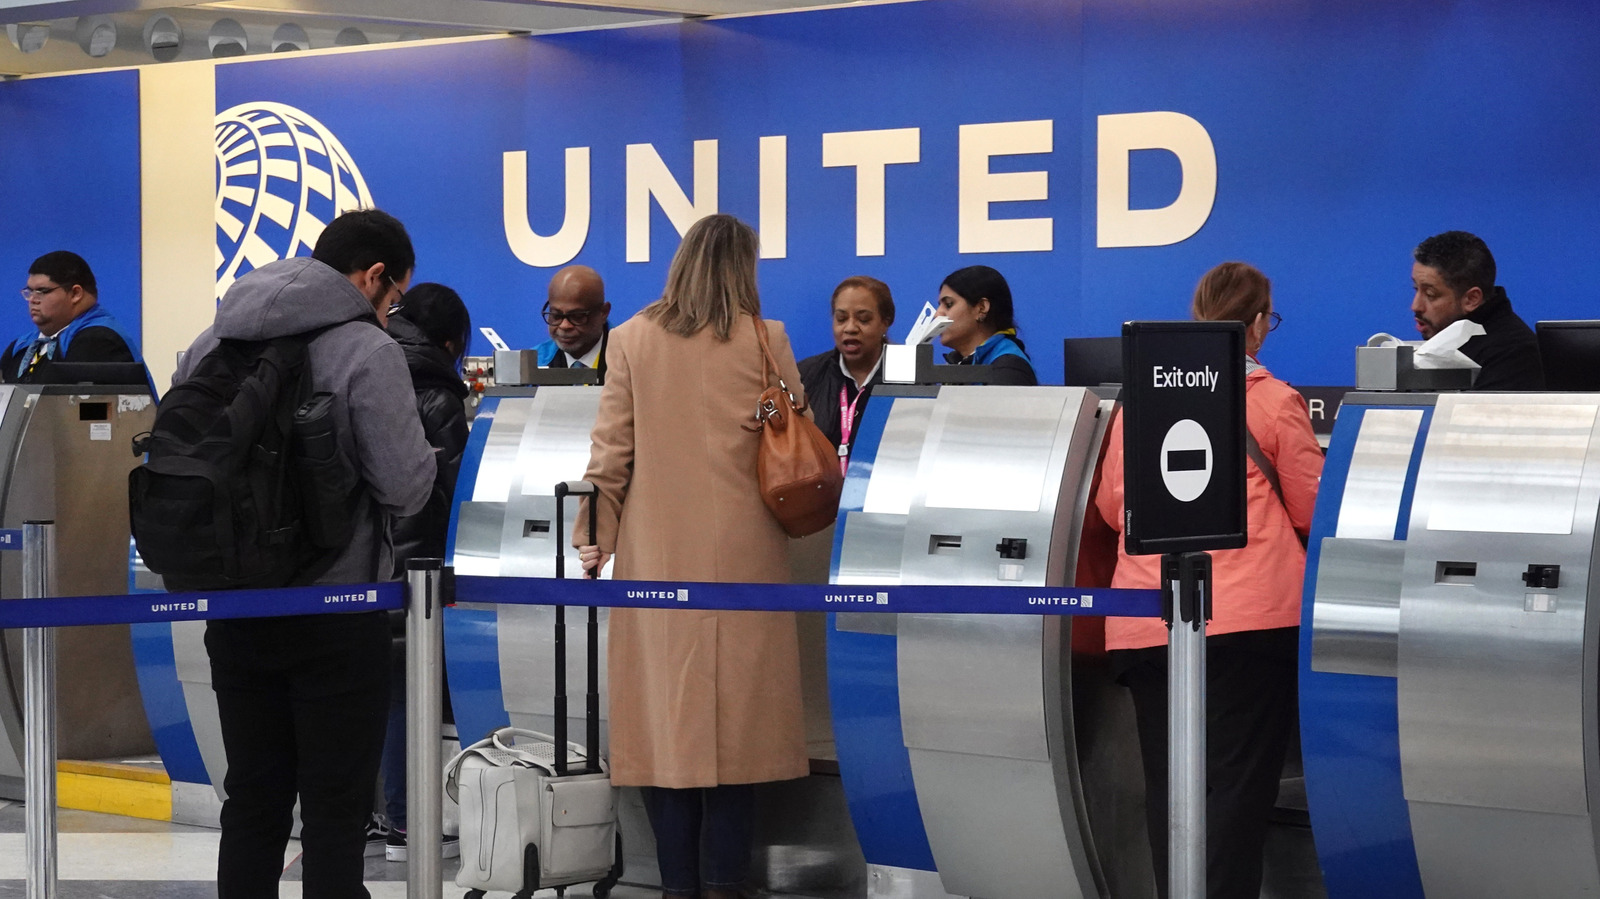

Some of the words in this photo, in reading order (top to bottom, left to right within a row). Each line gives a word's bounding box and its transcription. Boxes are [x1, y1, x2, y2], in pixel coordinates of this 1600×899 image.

[503, 110, 1218, 268] UNITED
[1153, 366, 1184, 388] Exit
[1185, 365, 1219, 392] only
[324, 593, 365, 603] UNITED
[627, 590, 675, 599] UNITED
[825, 594, 874, 603] UNITED
[1028, 597, 1078, 605] UNITED
[151, 602, 196, 612] UNITED
